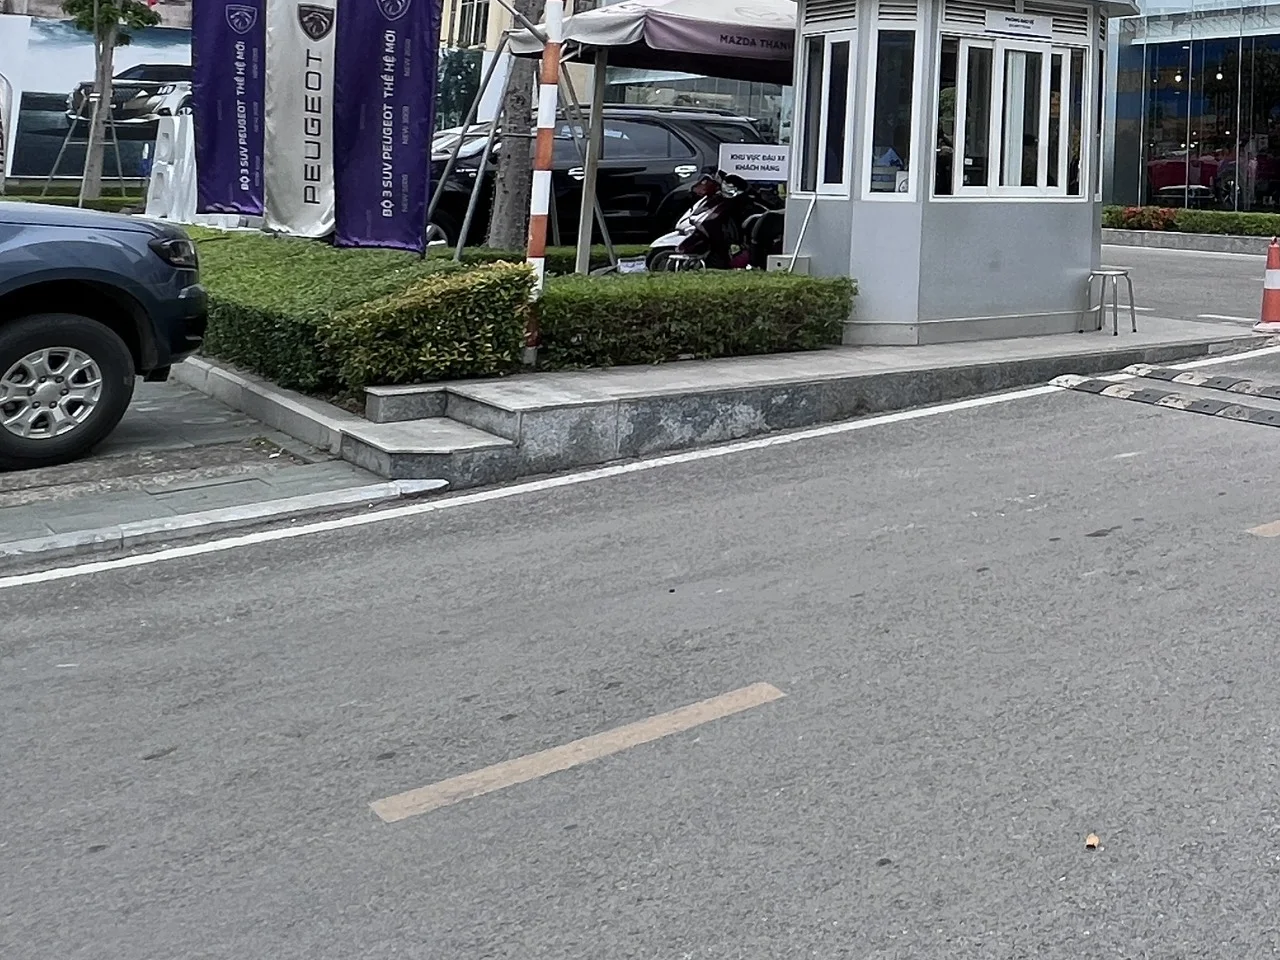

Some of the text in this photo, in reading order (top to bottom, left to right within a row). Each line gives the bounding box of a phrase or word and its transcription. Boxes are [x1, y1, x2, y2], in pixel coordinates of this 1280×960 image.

[720, 34, 757, 47] MAZDA
[237, 100, 248, 145] PEUGEOT
[304, 49, 322, 205] PEUGEOT
[380, 29, 396, 218] BỘ 3 SUV PEUGEOT THẾ HỆ MỚI
[239, 146, 249, 167] SUV
